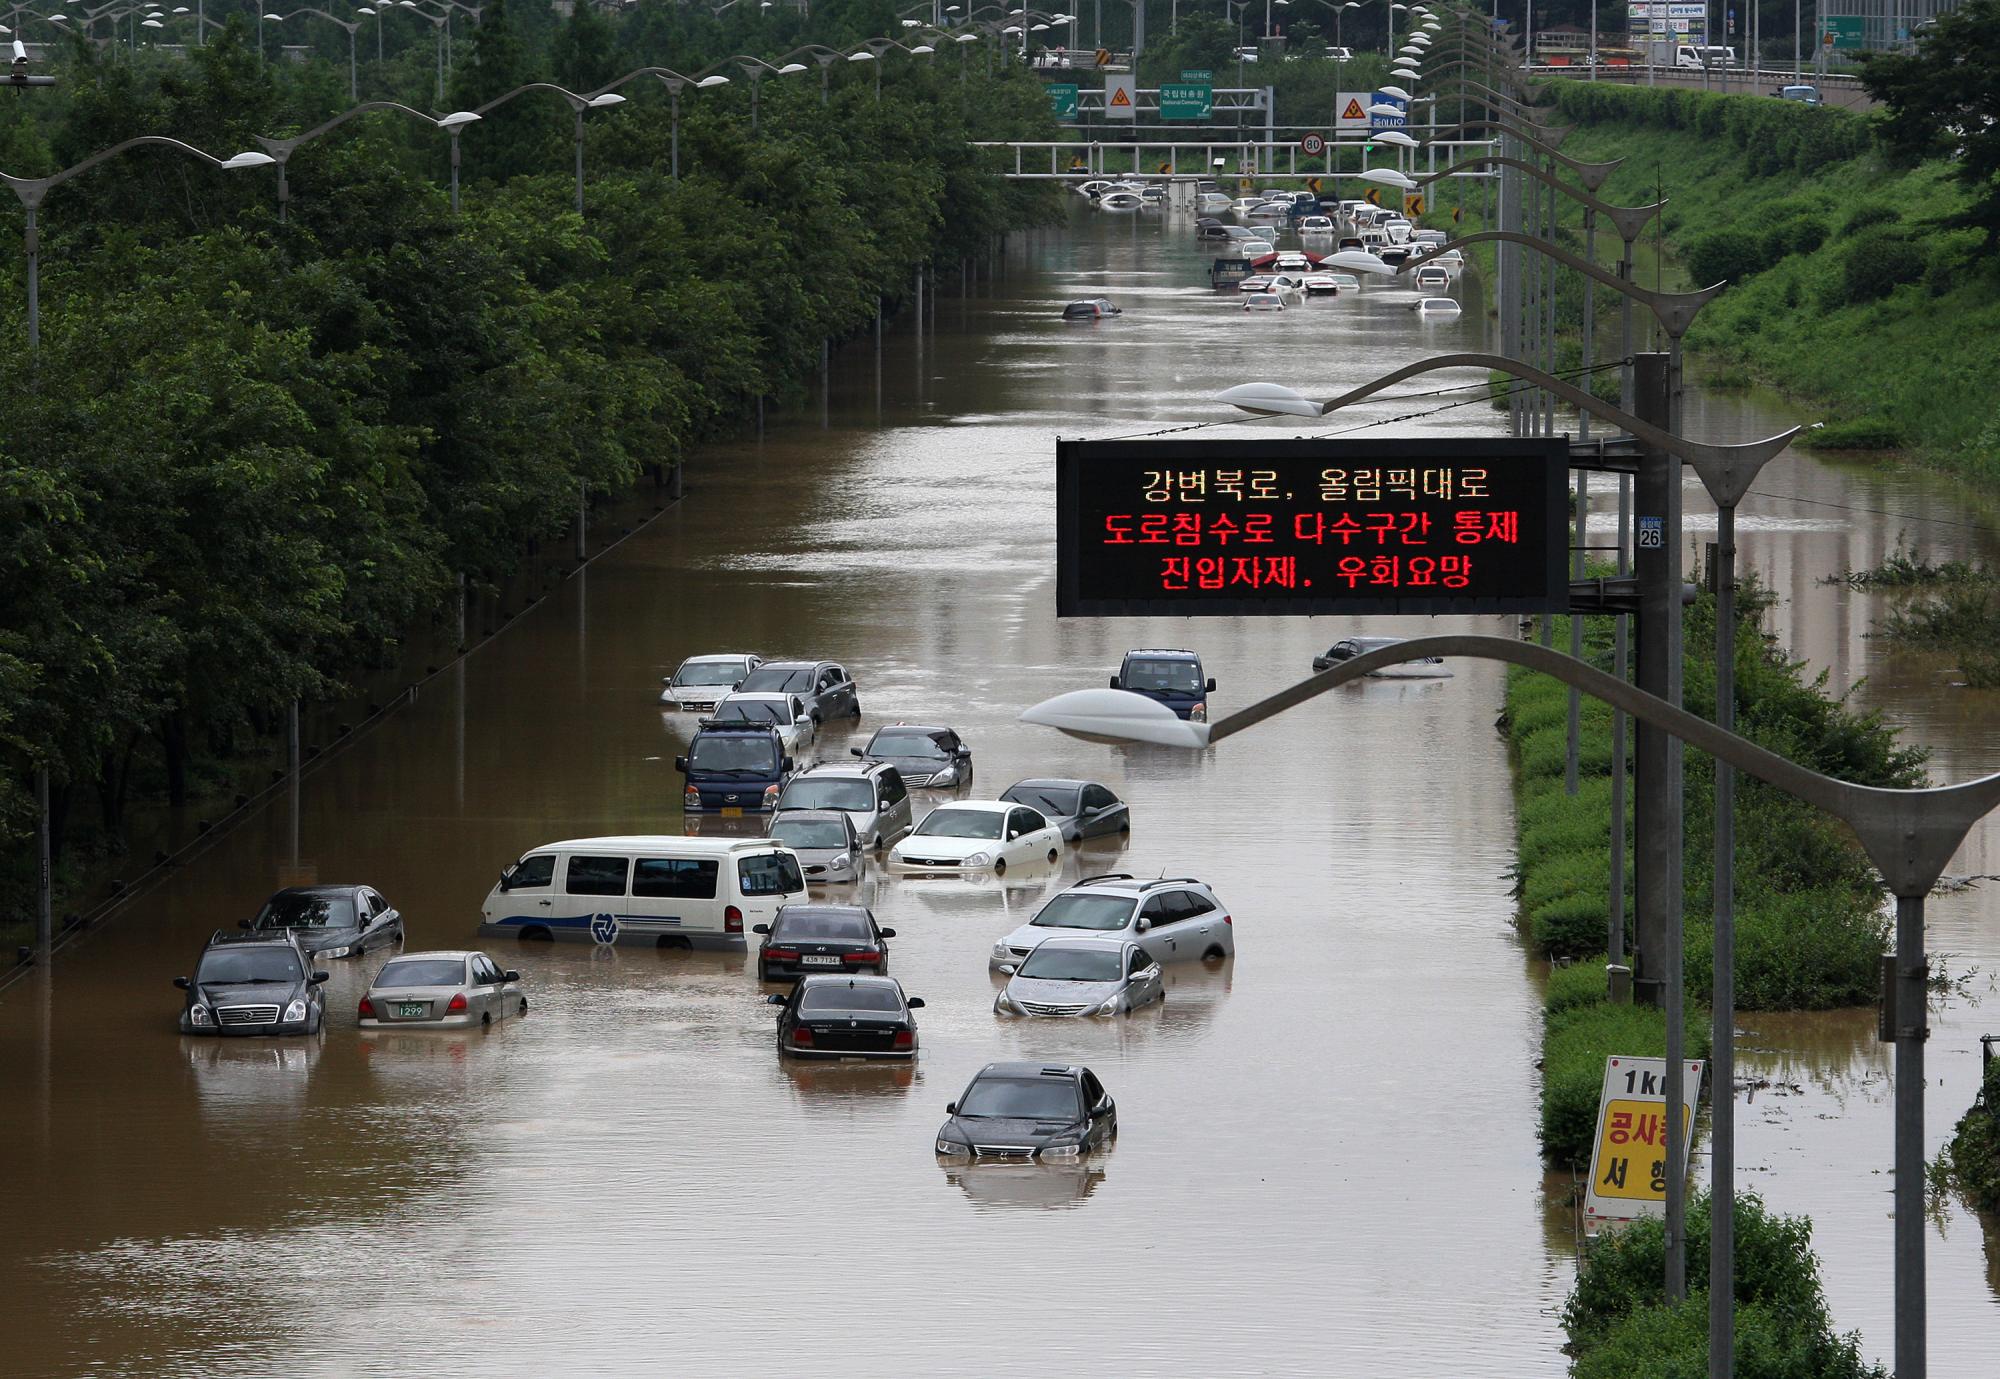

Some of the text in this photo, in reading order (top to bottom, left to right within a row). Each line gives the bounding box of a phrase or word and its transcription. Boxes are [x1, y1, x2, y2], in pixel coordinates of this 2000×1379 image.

[1306, 140, 1320, 150] 80
[1142, 468, 1490, 502] 강변북로, 올림픽대로
[1103, 510, 1519, 546] 도로침수로 다수구간 통제
[1641, 530, 1660, 546] 26
[1336, 555, 1472, 590] 우회요망
[400, 1007, 423, 1016] 1299
[1624, 1069, 1667, 1096] 1k
[1603, 1157, 1629, 1189] 서
